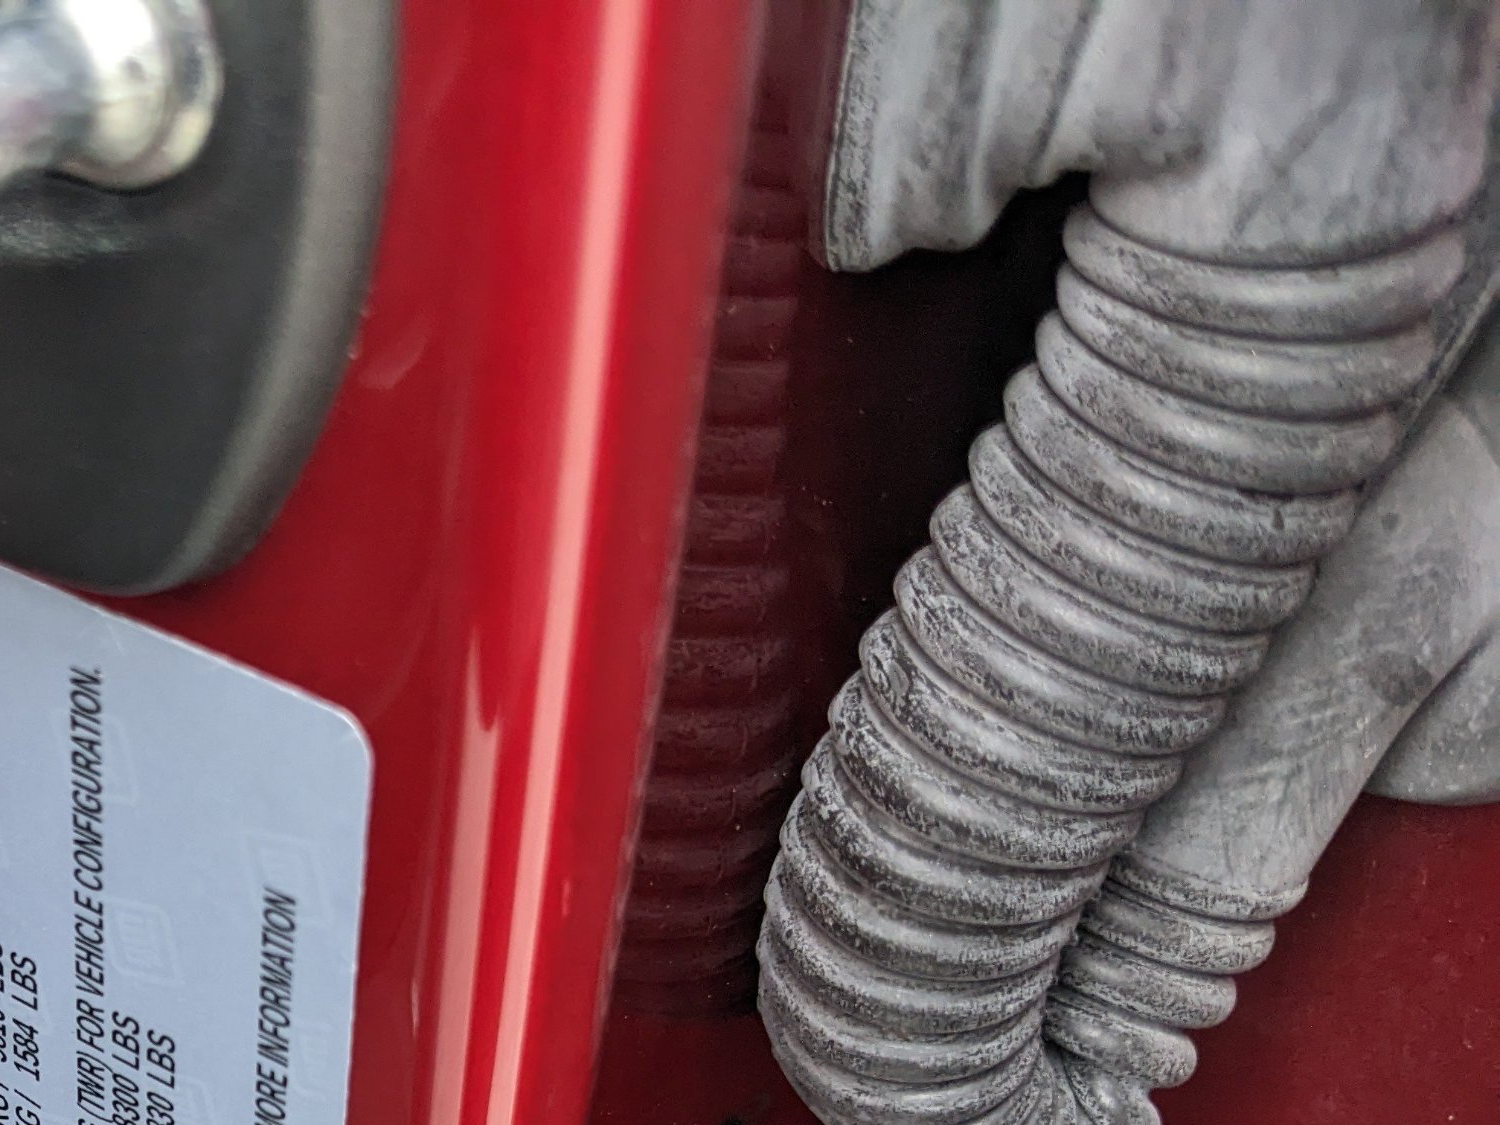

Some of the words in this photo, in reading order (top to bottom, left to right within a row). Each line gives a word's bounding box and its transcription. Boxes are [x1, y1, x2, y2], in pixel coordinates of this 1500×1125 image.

[69, 666, 104, 892] CONFIGURATION.
[74, 891, 105, 997] VEHICLE
[10, 951, 38, 1011] LBS
[256, 886, 297, 1068] INFORMATION
[12, 1018, 40, 1082] 1584
[75, 997, 105, 1053] FOR
[111, 1011, 140, 1071] LBS
[75, 1050, 114, 1123] (TWR)
[146, 1029, 176, 1089] LBS
